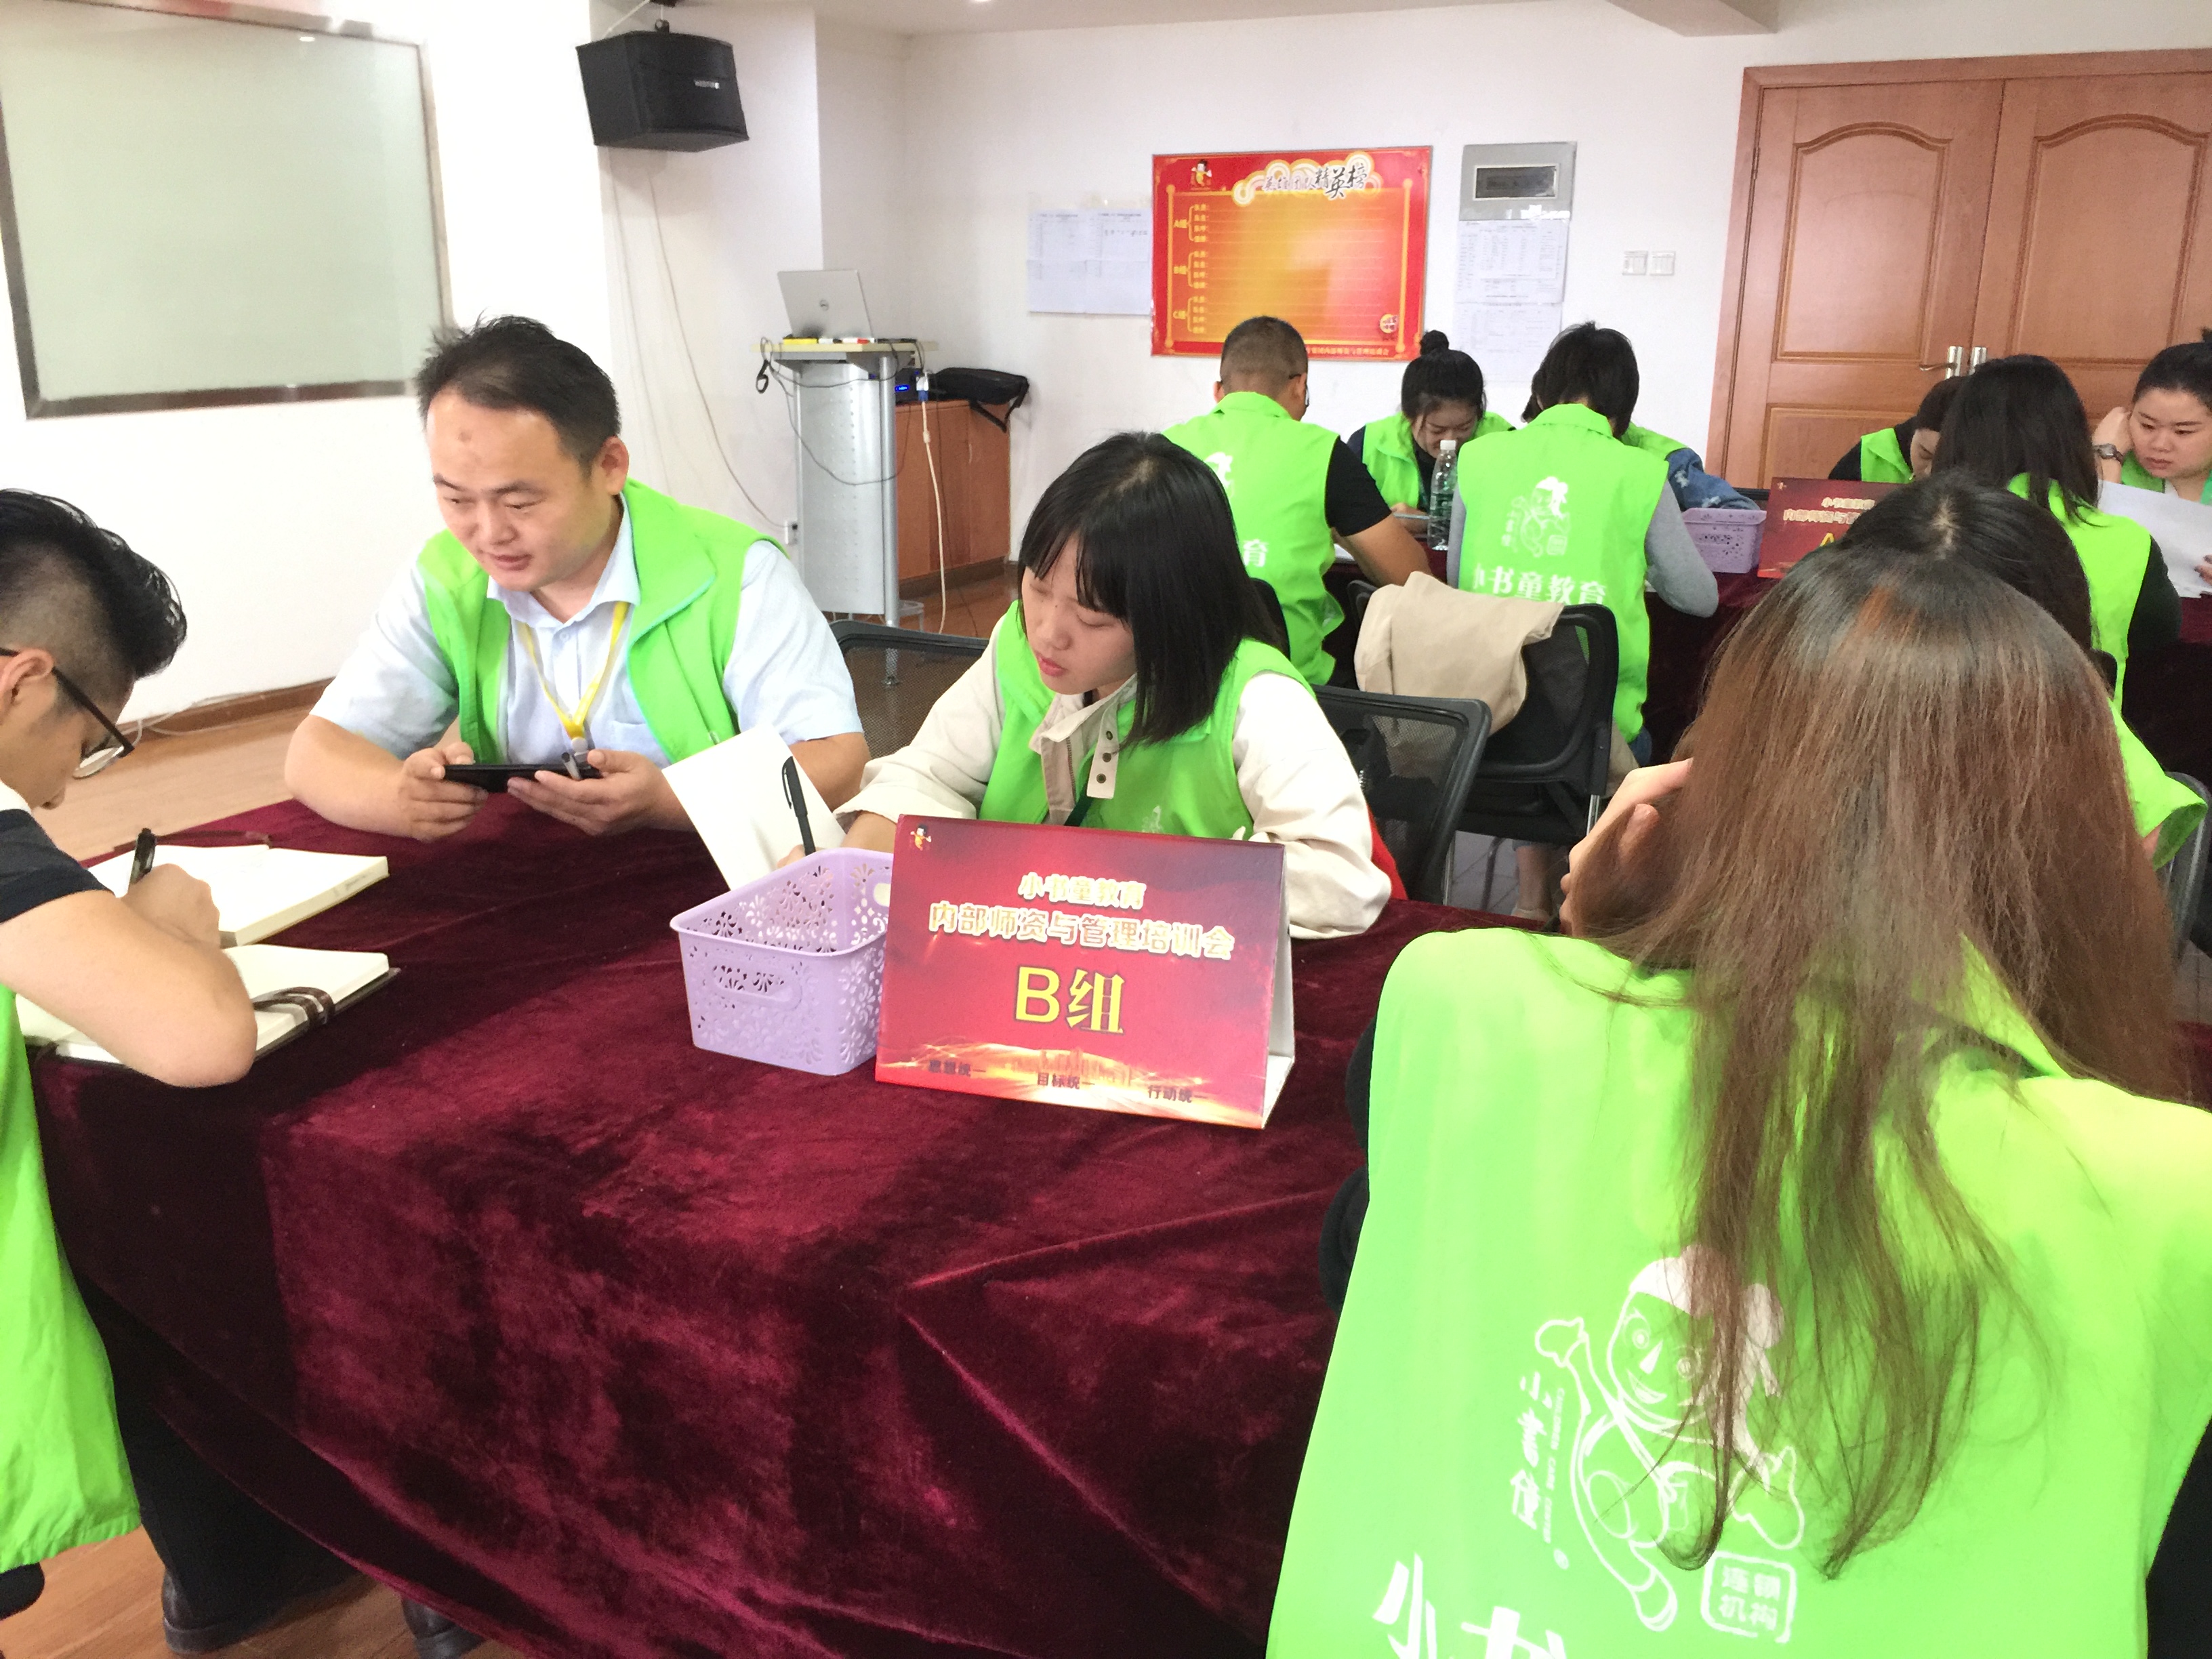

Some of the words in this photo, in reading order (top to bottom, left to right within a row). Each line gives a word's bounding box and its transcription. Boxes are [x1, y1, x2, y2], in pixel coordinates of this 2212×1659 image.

[1019, 873, 1145, 909] 小书童教育
[929, 901, 1233, 959] 内部师资与管理培训会
[1015, 966, 1125, 1034] B组
[1037, 1072, 1095, 1090] 目标统一
[1148, 1085, 1208, 1103] 行动统一
[1546, 1456, 1557, 1491] CARE
